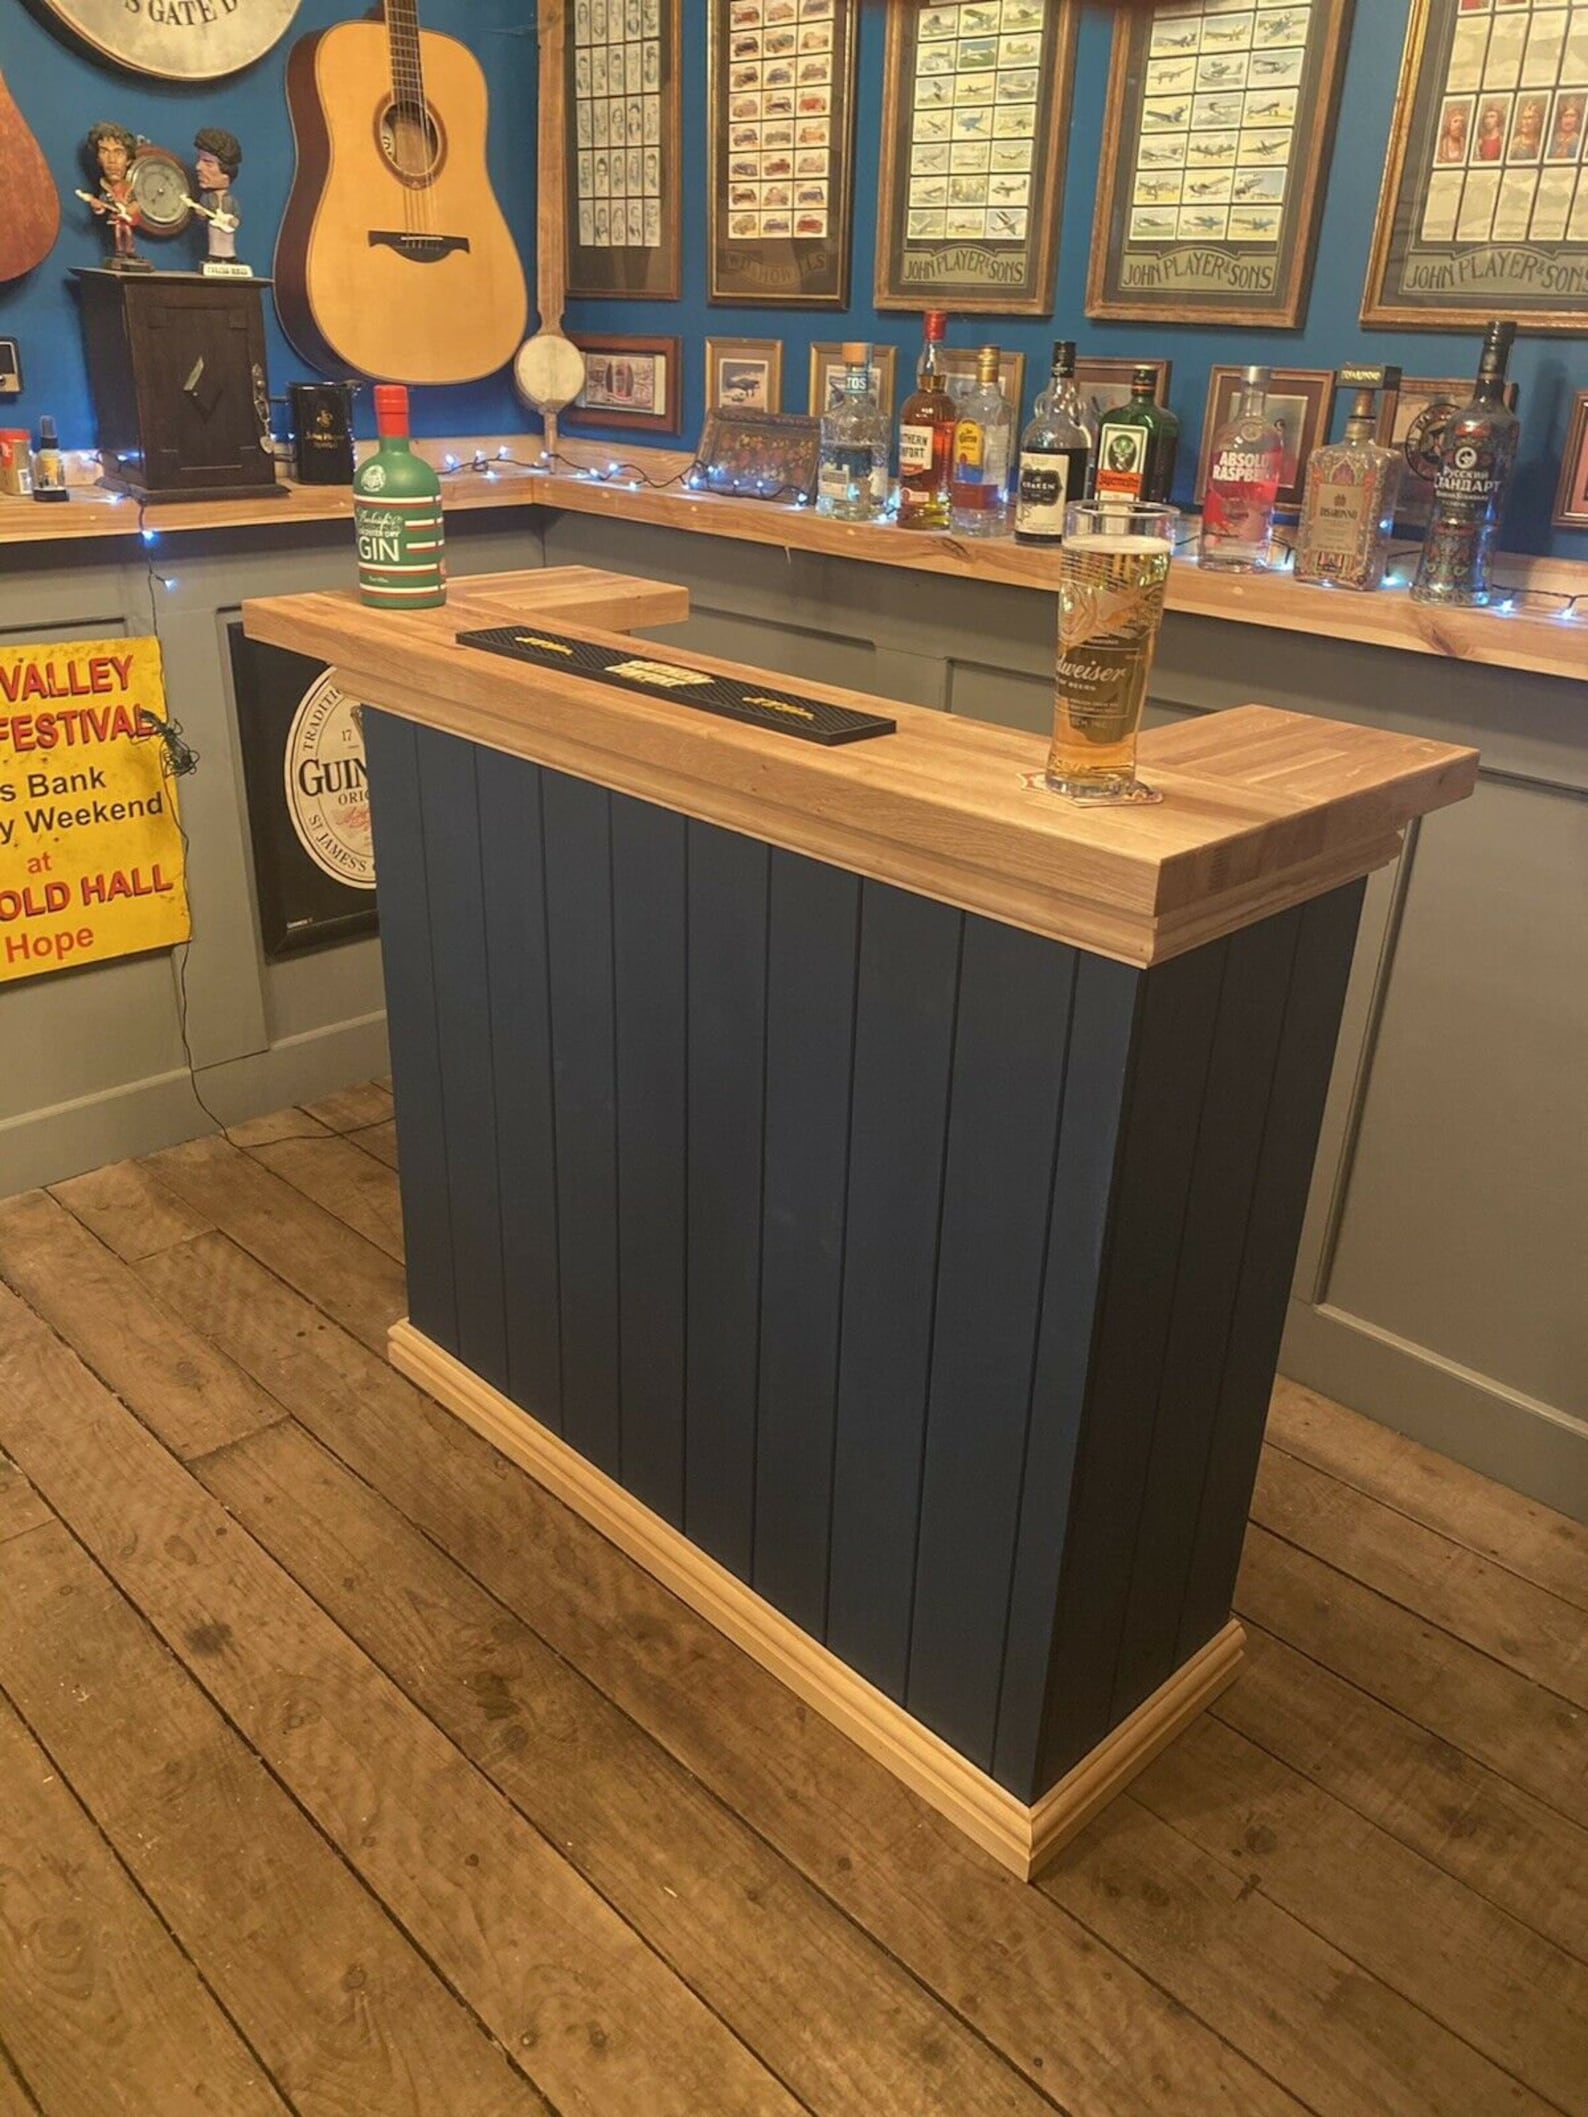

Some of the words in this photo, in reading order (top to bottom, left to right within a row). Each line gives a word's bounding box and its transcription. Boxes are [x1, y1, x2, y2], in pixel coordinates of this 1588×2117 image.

[148, 0, 217, 25] GATE
[905, 260, 936, 280] JOHN
[936, 249, 985, 275] PLAYER
[988, 260, 1024, 282] SONS
[1123, 262, 1162, 286] JOHN
[1163, 251, 1225, 280] PLAYER
[1227, 264, 1273, 289] SONS
[1405, 264, 1454, 289] JOHN
[1458, 250, 1537, 283] PLAYER
[359, 536, 400, 562] GIN
[0, 655, 133, 702] VALLEY
[28, 766, 107, 798] Bank
[24, 791, 164, 834] Weekend
[27, 852, 52, 874] at
[0, 882, 70, 922] OLD
[81, 864, 174, 906] HALL
[5, 927, 94, 963] Hope
